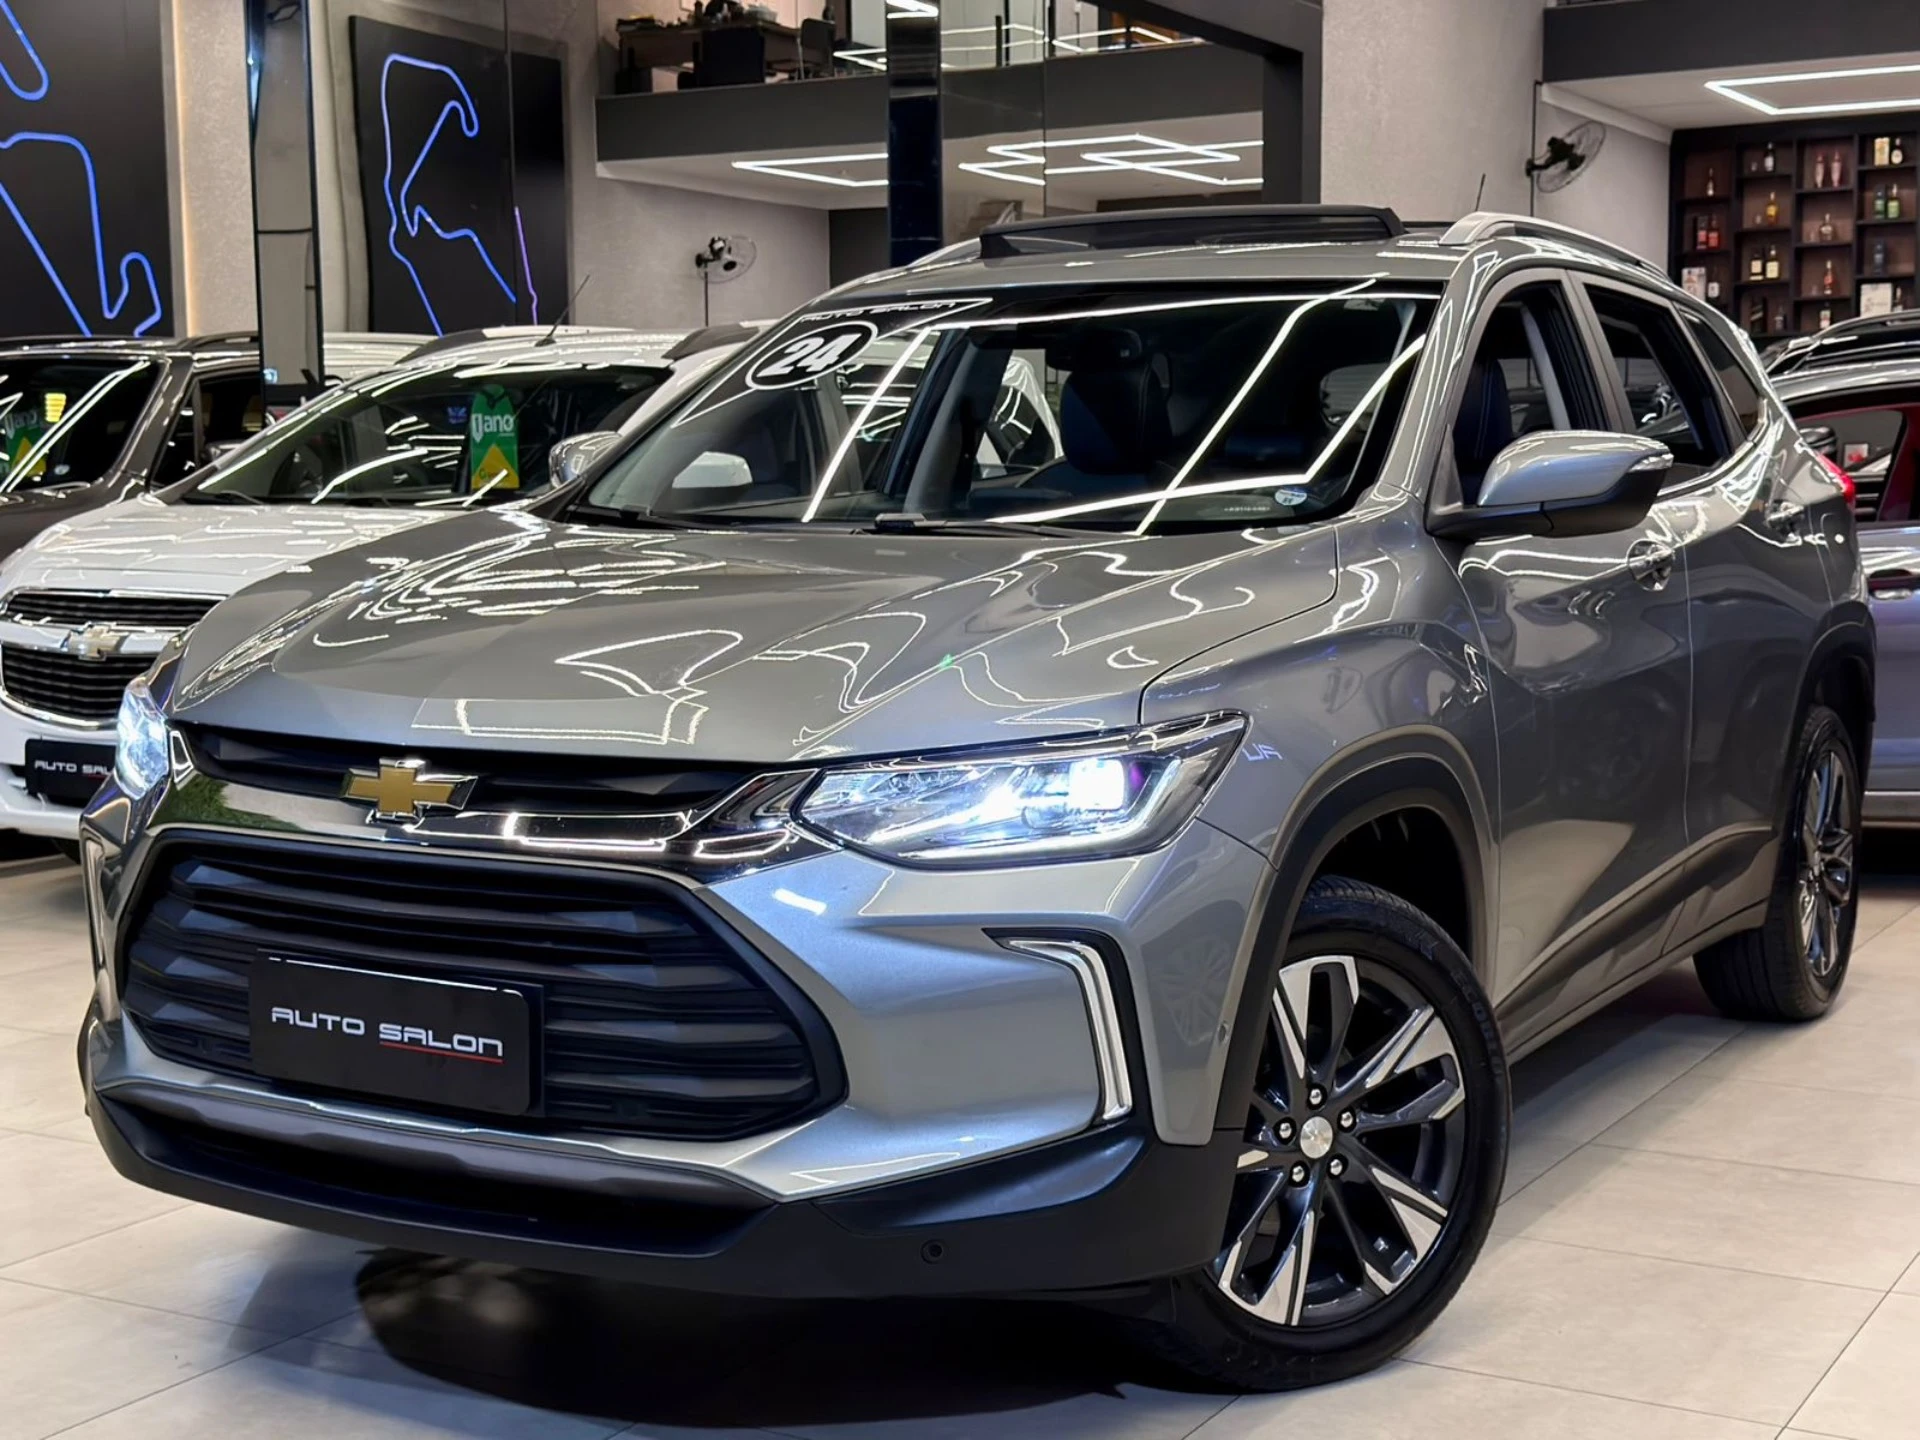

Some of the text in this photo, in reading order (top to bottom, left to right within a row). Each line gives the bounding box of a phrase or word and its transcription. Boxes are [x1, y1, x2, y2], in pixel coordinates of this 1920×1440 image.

[756, 333, 863, 378] 24
[34, 760, 112, 776] AUTO SAL
[271, 1006, 504, 1057] AUTO SALON
